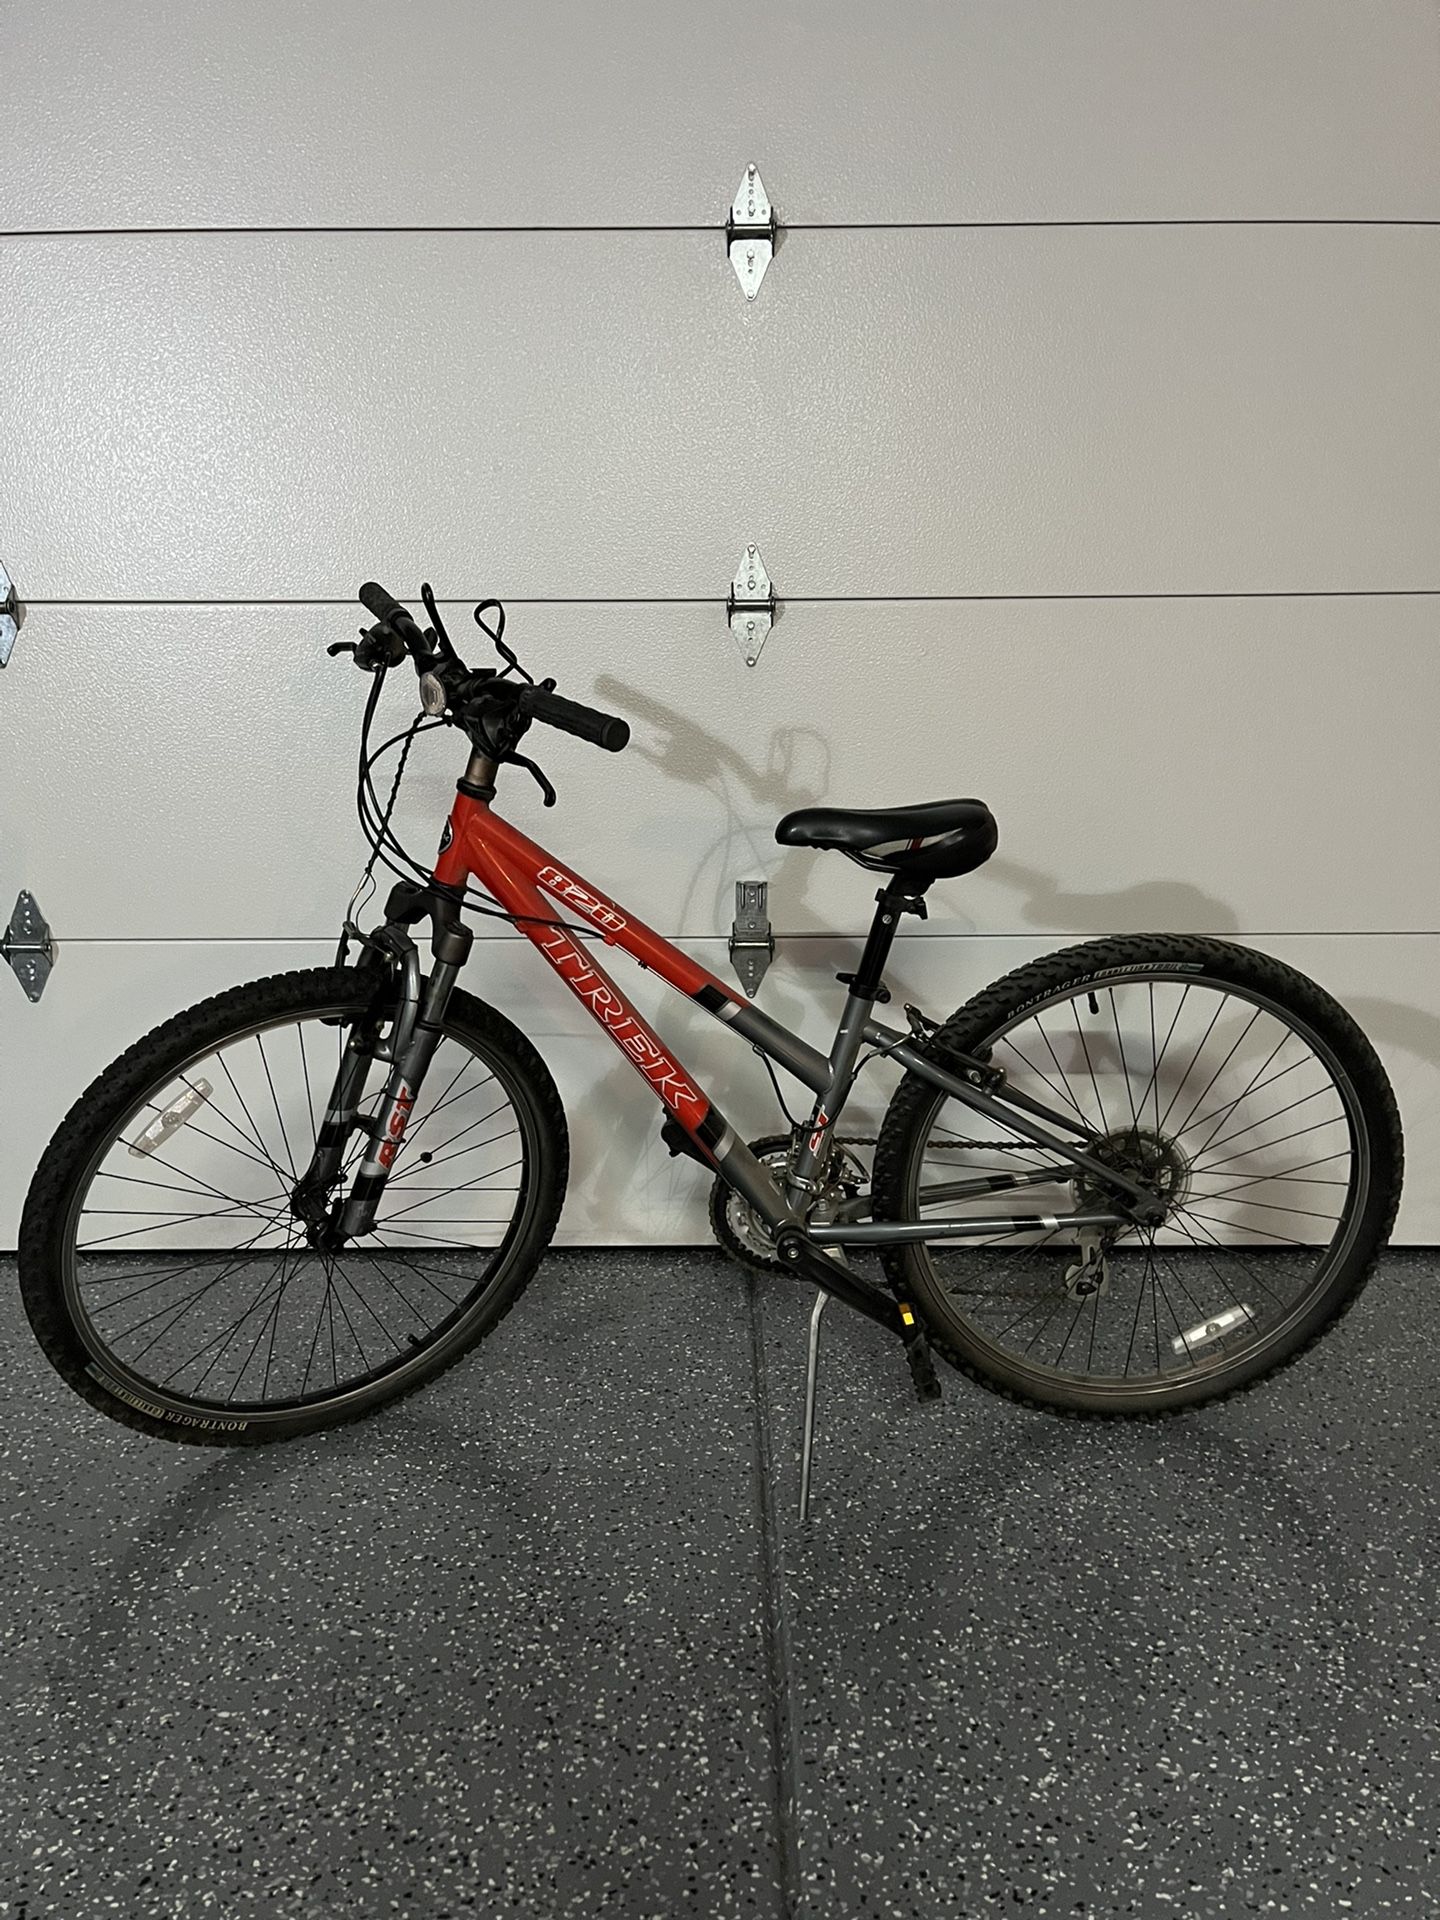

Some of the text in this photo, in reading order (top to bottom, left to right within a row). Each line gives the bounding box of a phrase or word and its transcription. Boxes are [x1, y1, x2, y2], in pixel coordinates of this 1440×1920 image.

[537, 866, 627, 931] 820
[541, 923, 698, 1109] TREK
[1007, 974, 1091, 1019] BONTRAGER
[375, 1081, 415, 1169] RST
[165, 1411, 249, 1432] BONTRAGER
